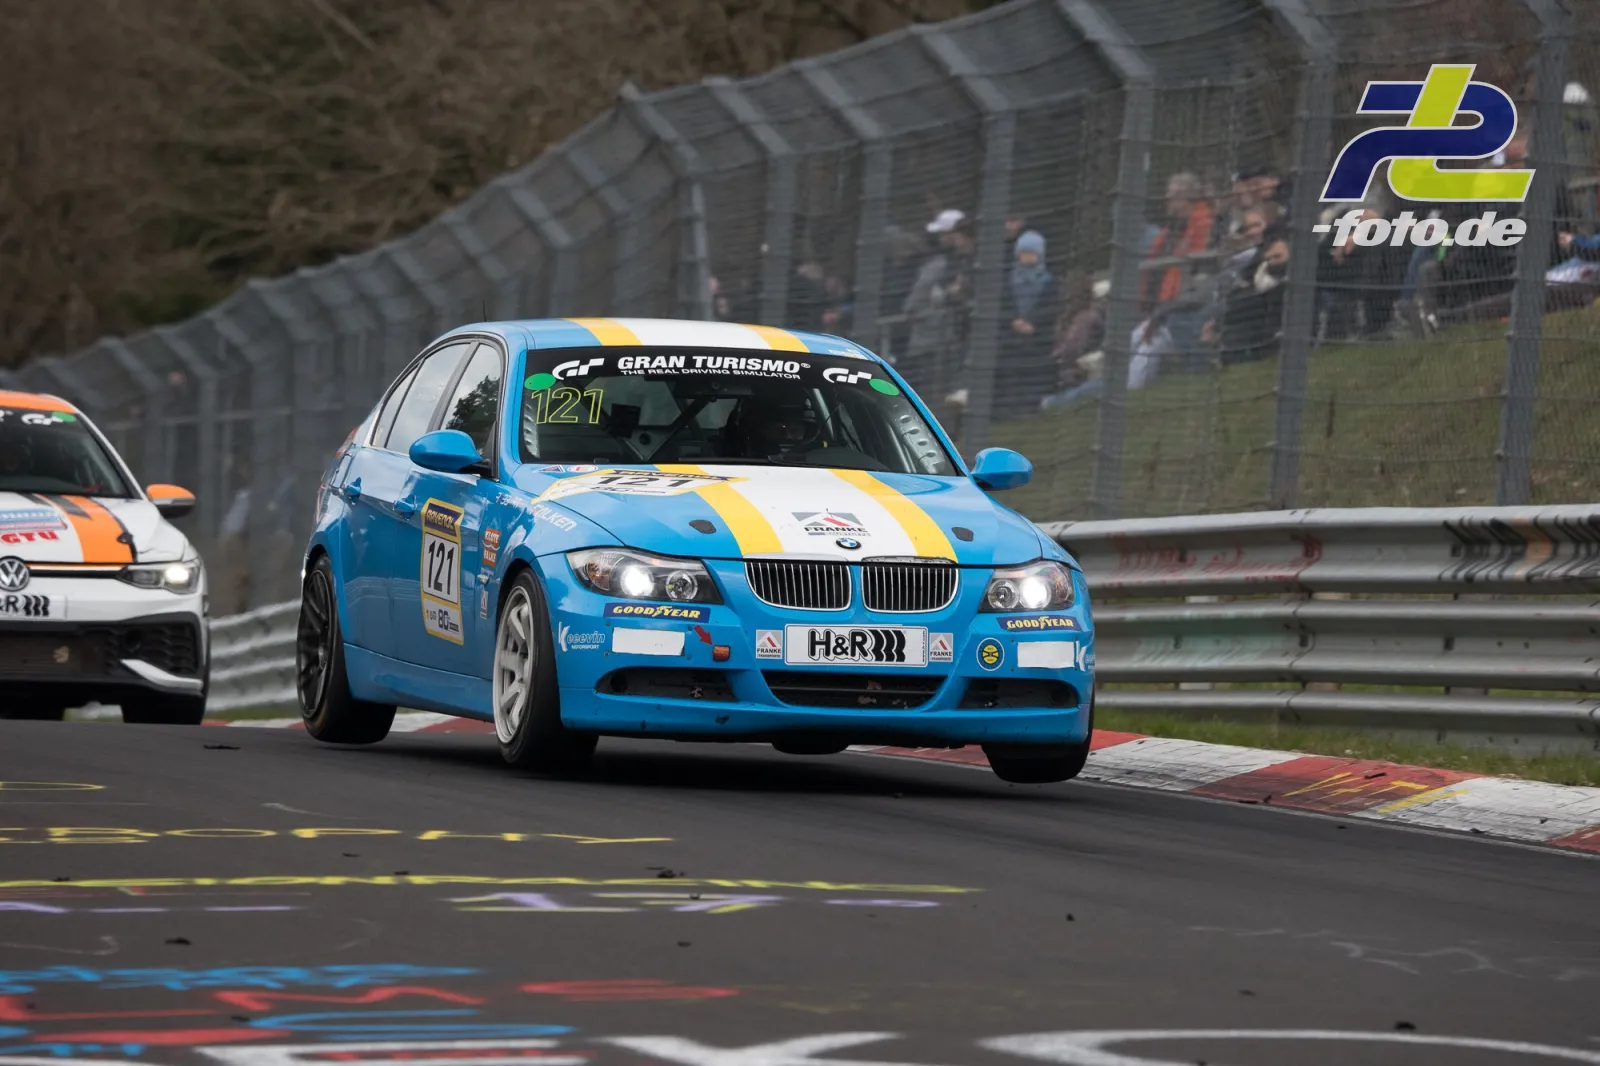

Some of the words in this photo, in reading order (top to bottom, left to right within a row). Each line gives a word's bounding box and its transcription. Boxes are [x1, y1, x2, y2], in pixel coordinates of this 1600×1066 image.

[617, 356, 685, 370] GRAN
[733, 369, 801, 379] SIMULATOR
[531, 387, 603, 424] 121
[597, 476, 694, 487] 121
[428, 539, 455, 595] 121
[613, 605, 701, 619] GOODYEAR
[1007, 616, 1074, 629] GOODYEAR
[808, 628, 873, 662] H&R
